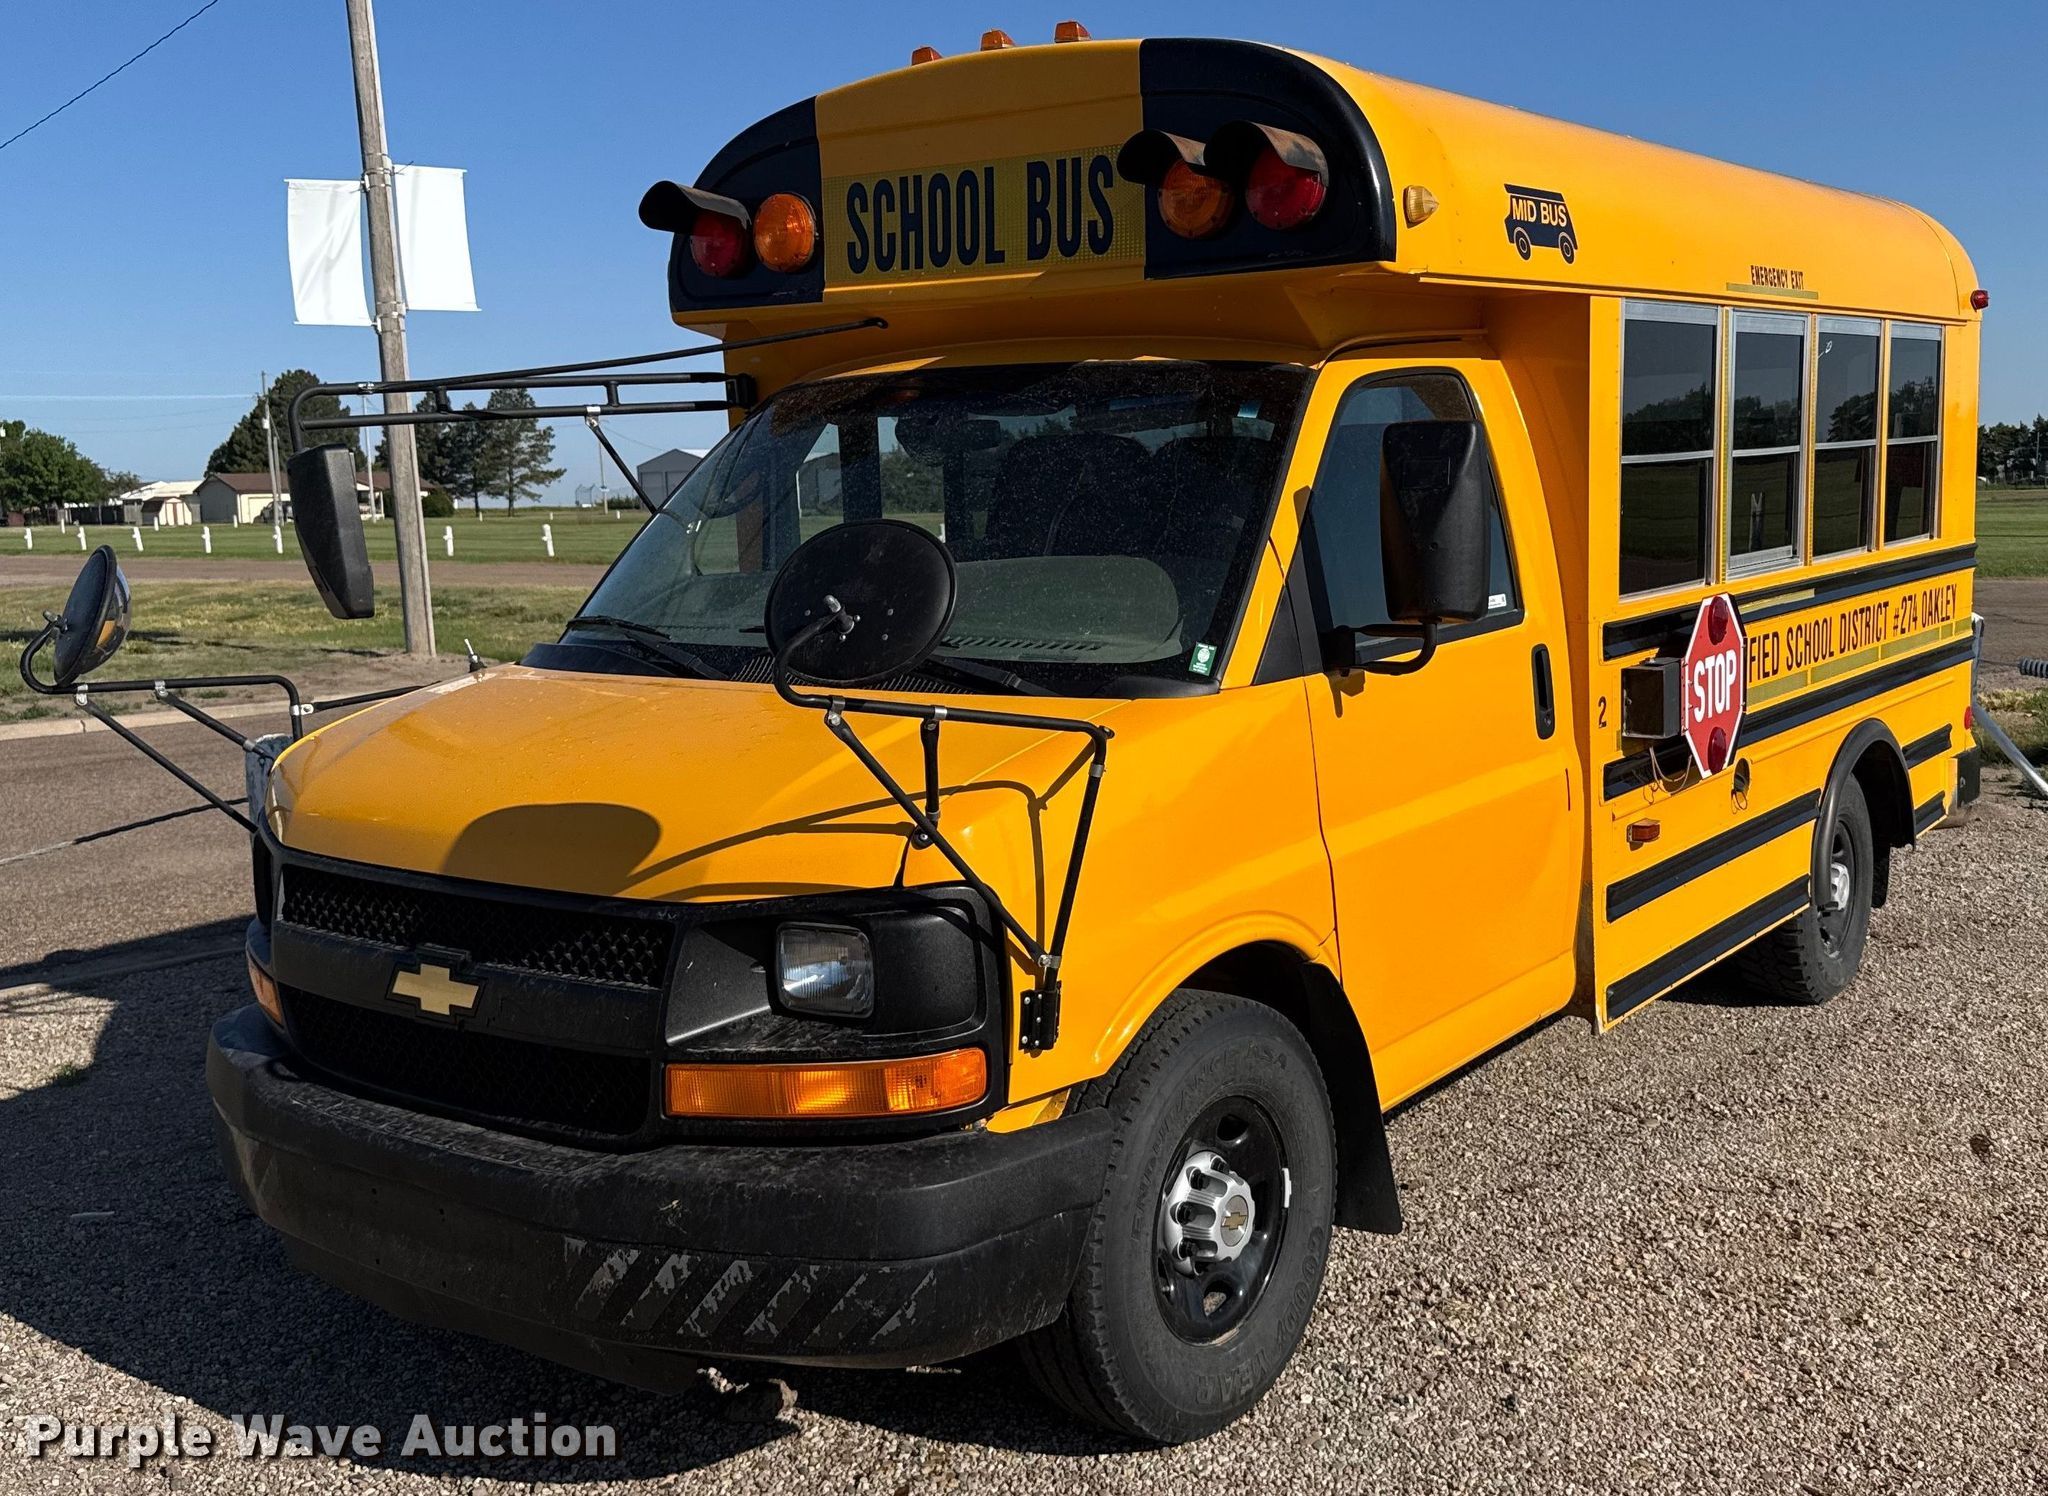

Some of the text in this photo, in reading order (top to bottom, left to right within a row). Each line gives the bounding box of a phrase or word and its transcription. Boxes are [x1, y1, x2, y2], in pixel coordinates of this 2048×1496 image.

[846, 154, 1114, 274] SCHOOL BUS
[1511, 197, 1567, 227] MID BUS
[1750, 264, 1805, 290] EMERGENCY EXIT
[1786, 616, 1834, 672] SCHOOL
[1839, 601, 1889, 655] DISTRICT
[1892, 593, 1918, 637] #274
[1921, 583, 1957, 628] OAKLEY
[1597, 696, 1607, 729] 2
[1693, 649, 1737, 723] STOP
